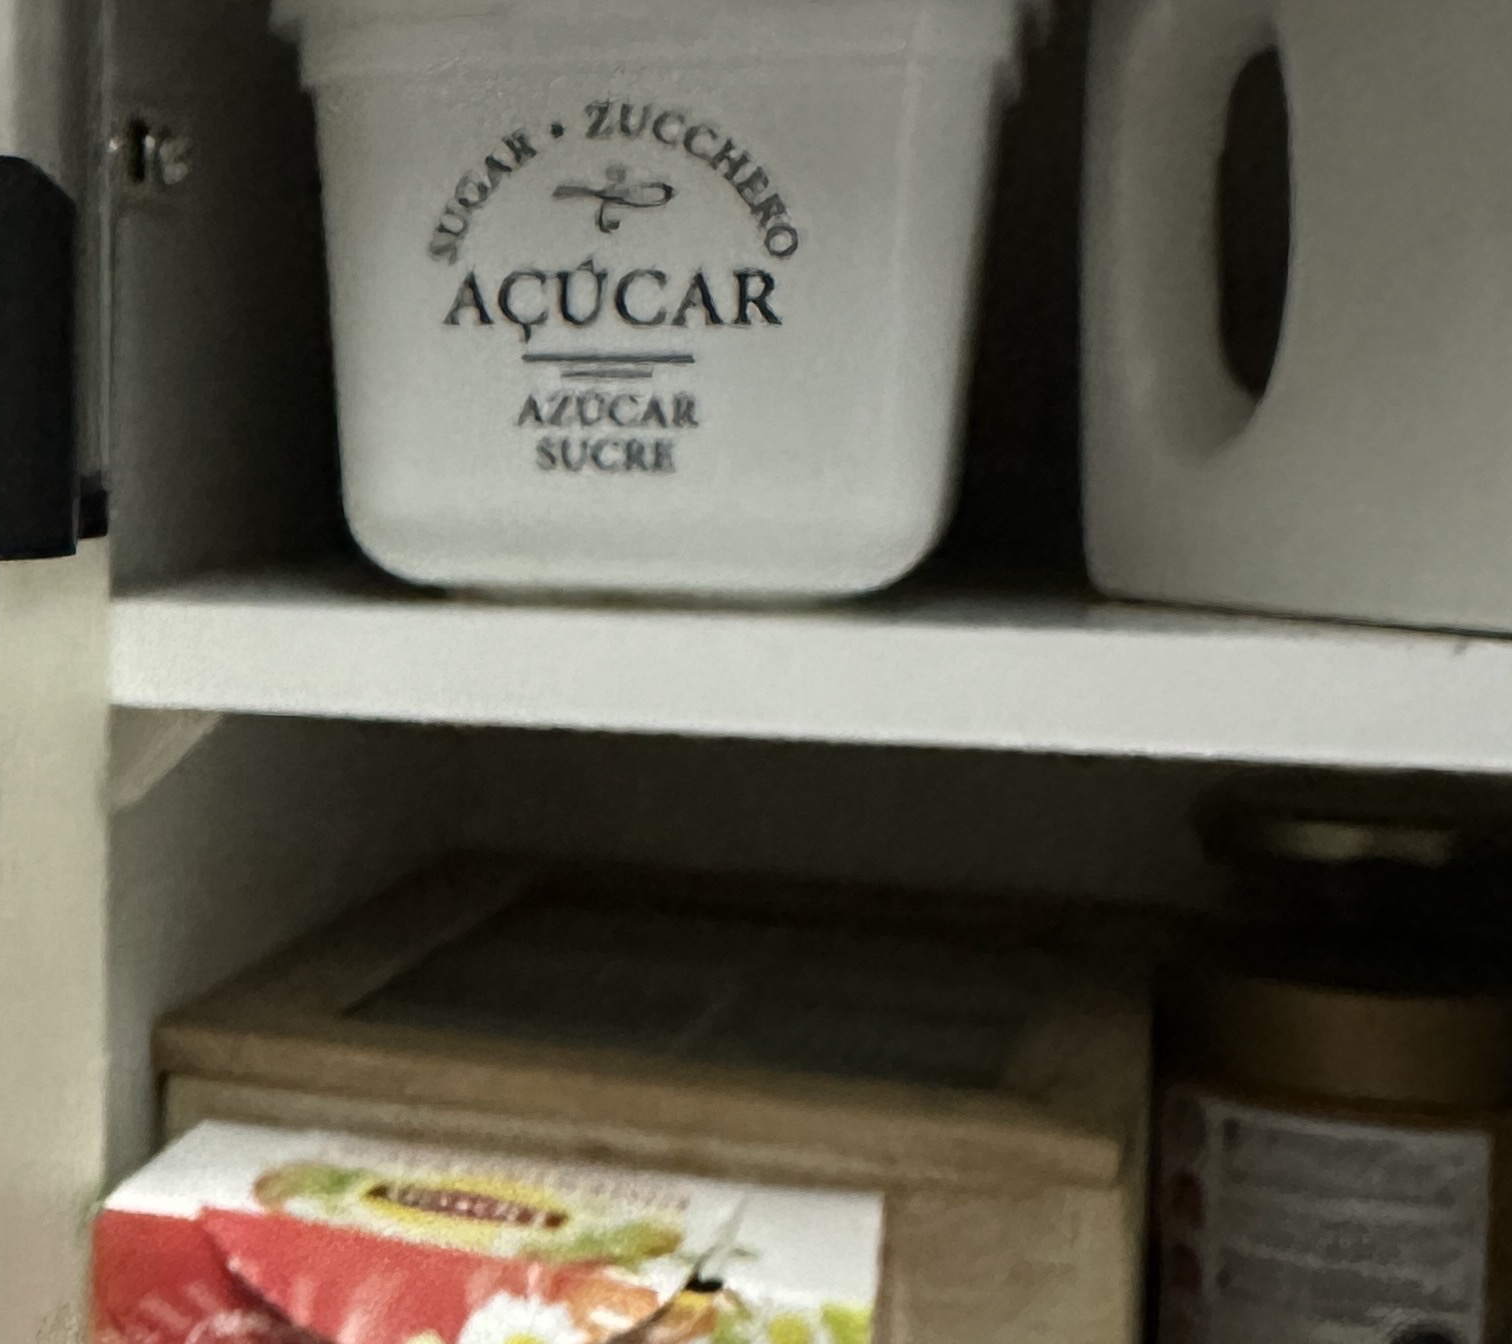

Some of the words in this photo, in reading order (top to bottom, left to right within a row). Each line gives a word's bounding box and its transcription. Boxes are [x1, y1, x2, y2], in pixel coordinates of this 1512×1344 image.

[429, 128, 539, 264] SUGAR
[584, 98, 799, 259] ZUCCHERO
[442, 256, 784, 343] AÇÚCAR
[535, 436, 676, 473] SUCRE
